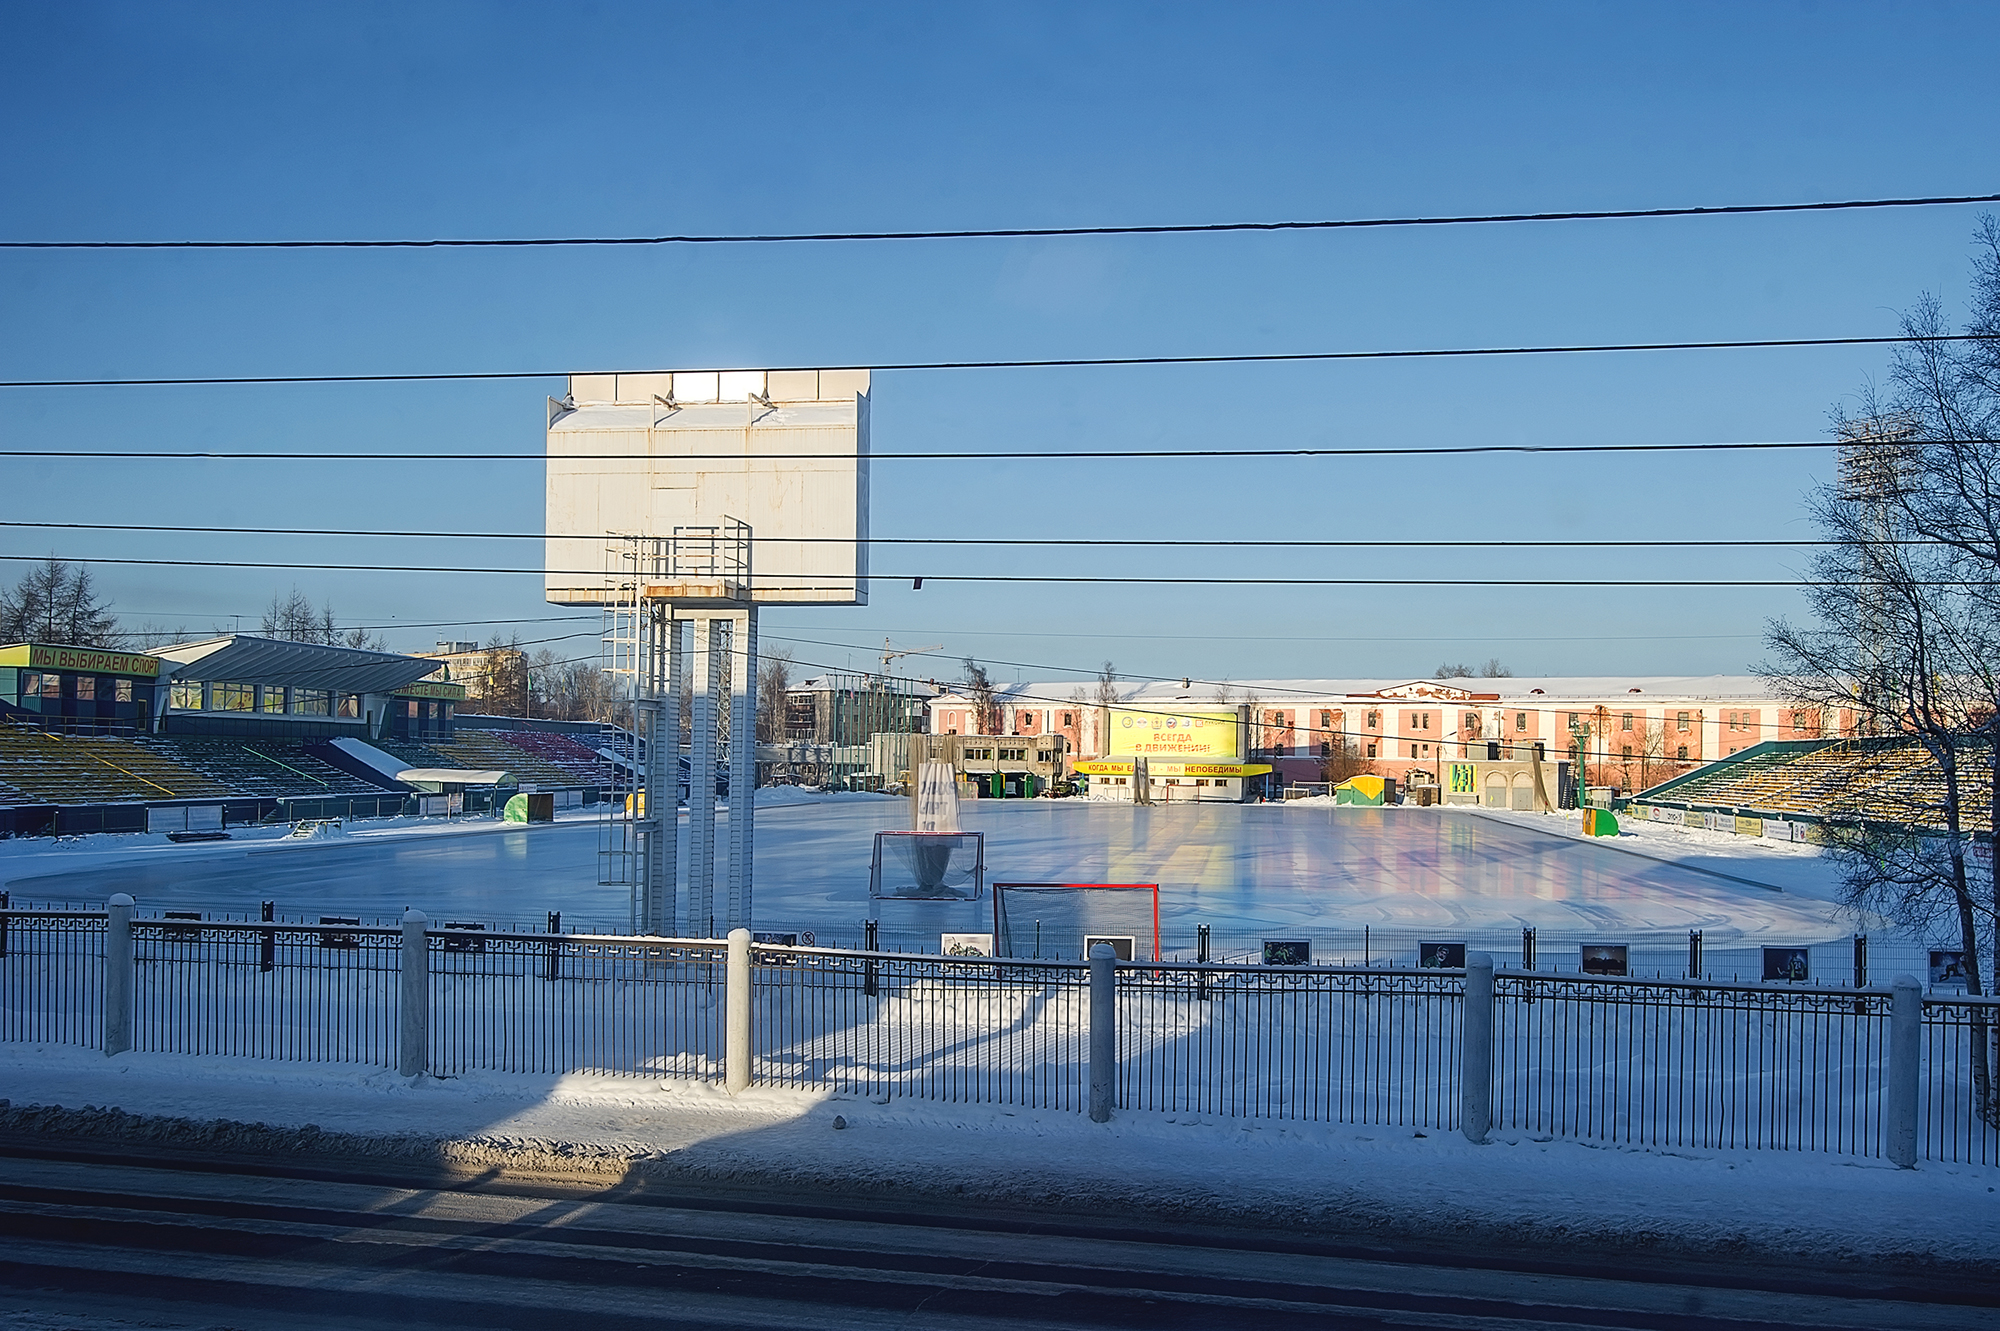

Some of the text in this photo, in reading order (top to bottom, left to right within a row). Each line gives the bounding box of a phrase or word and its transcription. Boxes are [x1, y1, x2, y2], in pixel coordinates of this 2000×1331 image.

[32, 648, 158, 674] МЫ ВЫБИРАЕМ СПОРТ
[430, 685, 442, 697] МЫ
[443, 686, 460, 698] СИЛА
[1153, 733, 1192, 743] ВСЕГДА
[1135, 743, 1142, 752] В
[1088, 764, 1109, 772] КОГДА
[1111, 764, 1124, 772] МЫ
[1166, 765, 1181, 773] МЫ
[1184, 765, 1242, 774] НЕПОБЕДИМЫ
